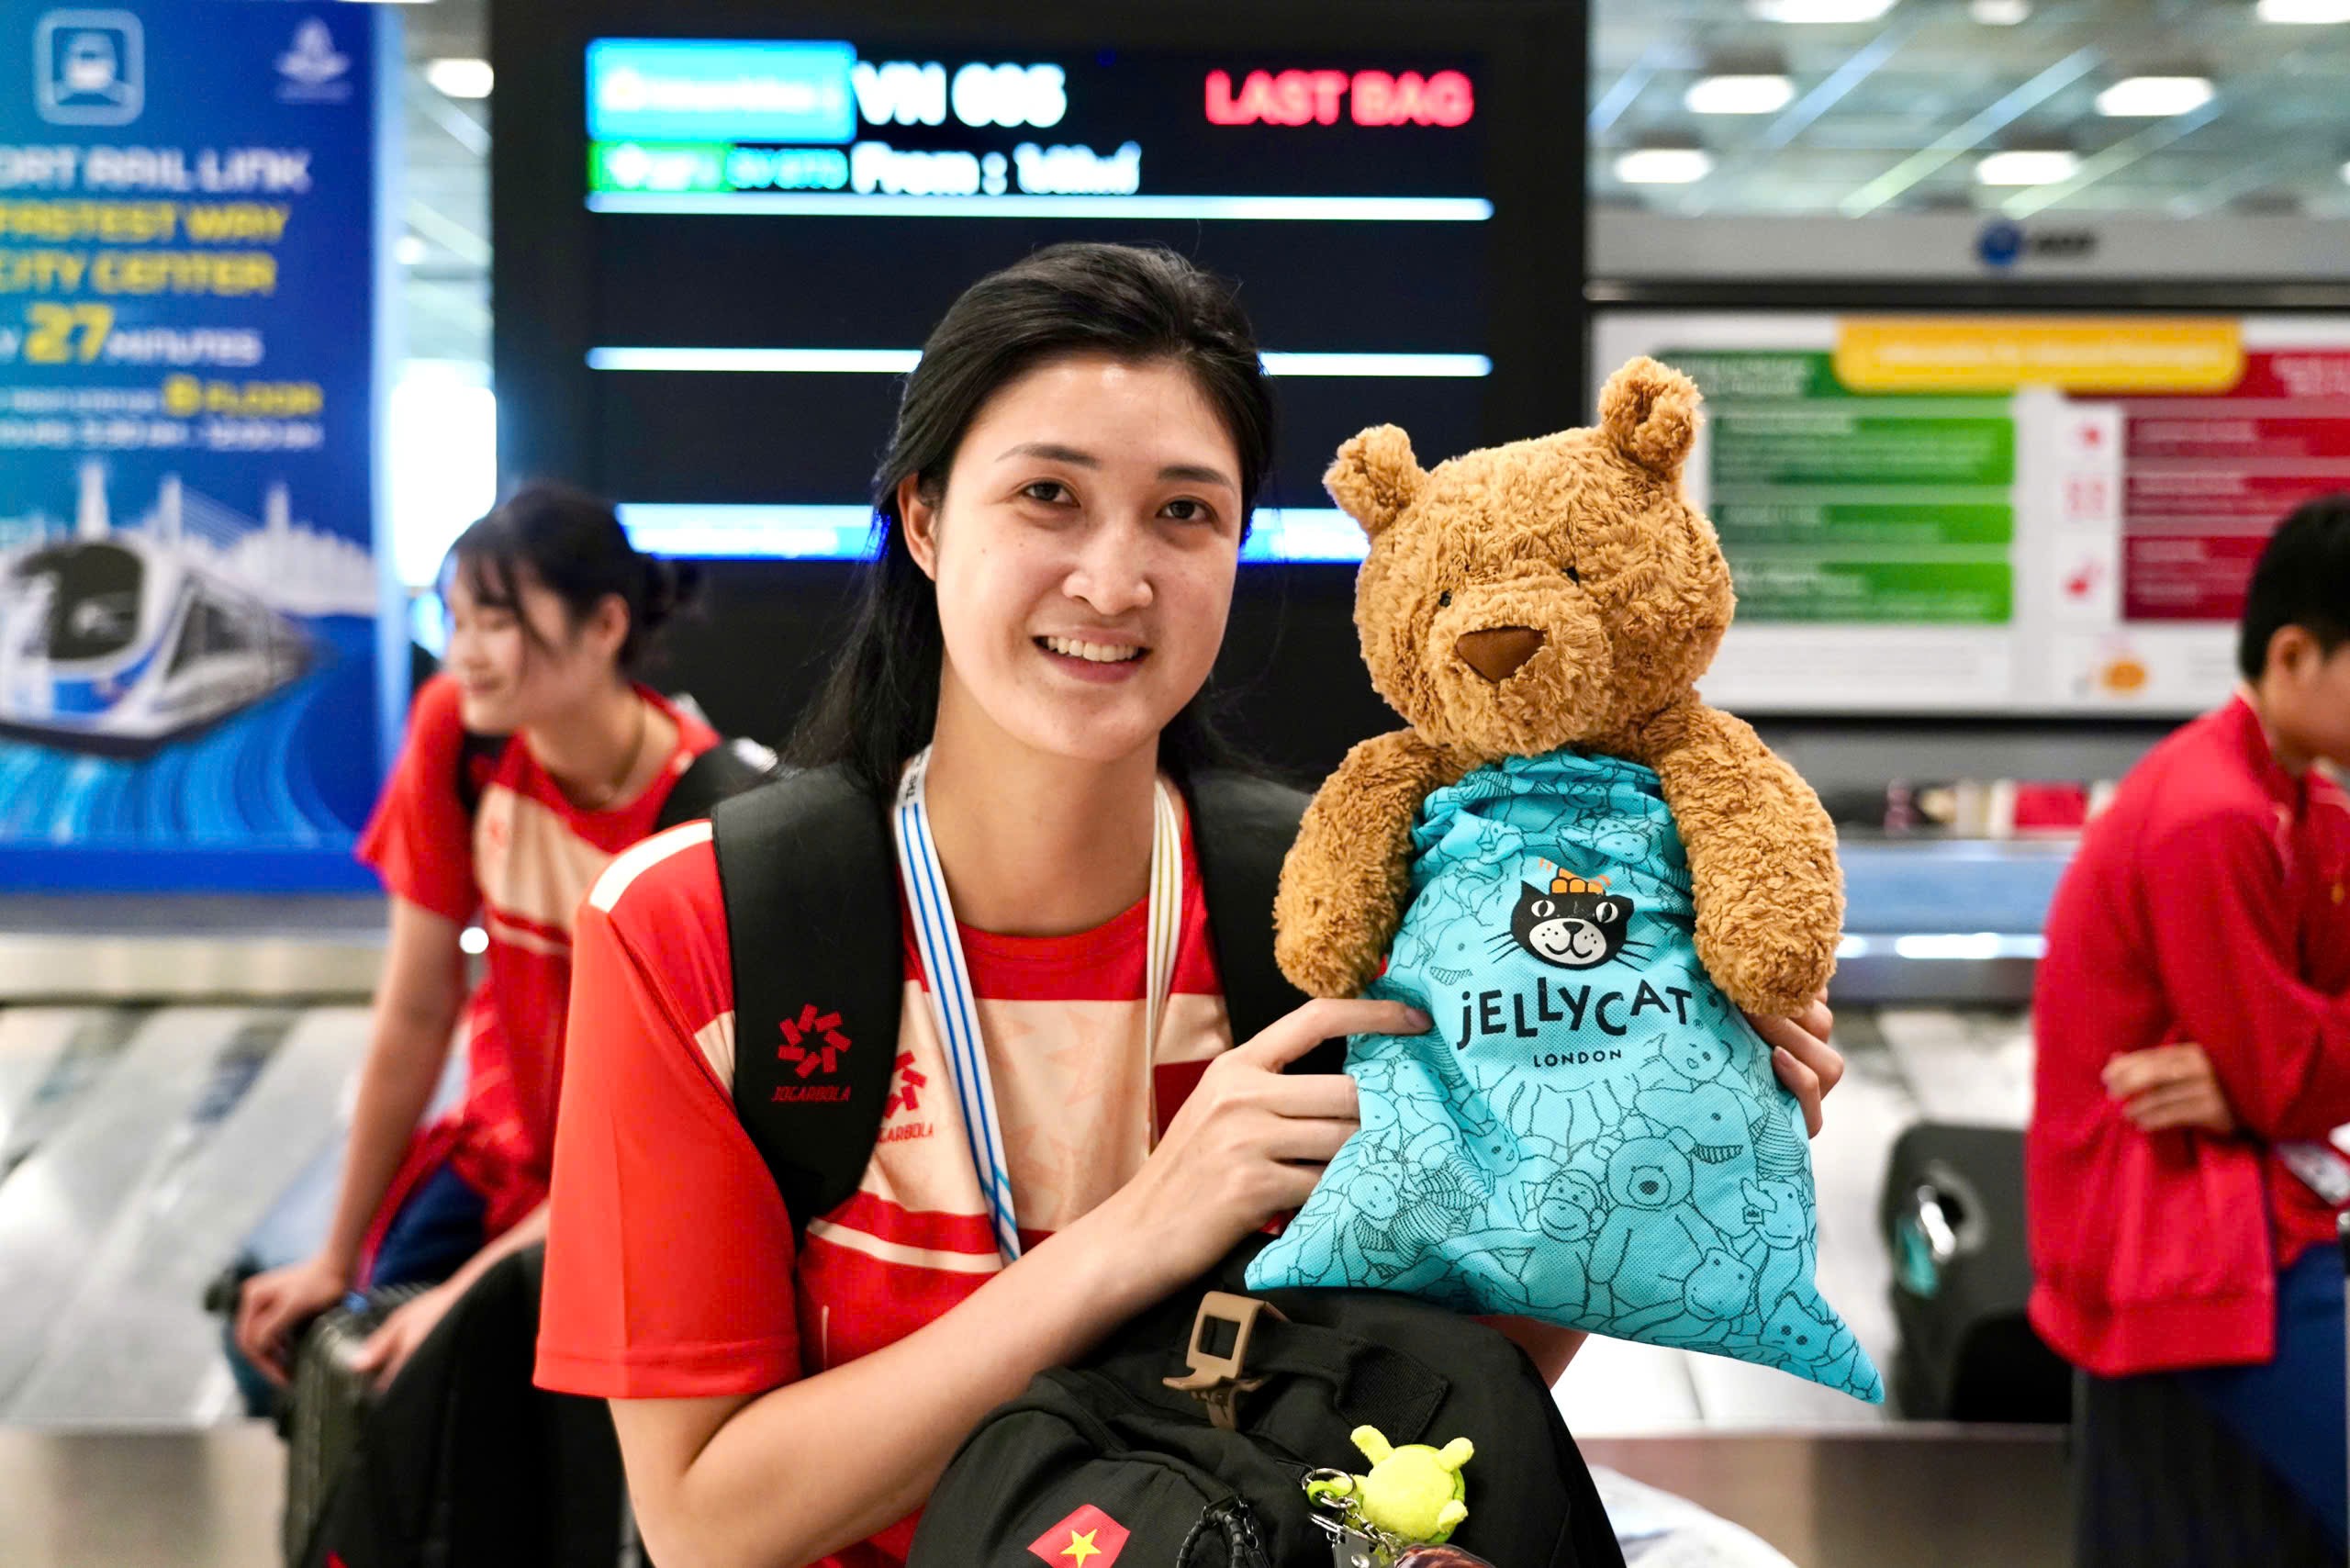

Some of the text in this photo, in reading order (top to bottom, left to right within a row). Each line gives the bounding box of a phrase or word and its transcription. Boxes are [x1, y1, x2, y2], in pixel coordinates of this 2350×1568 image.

[1205, 70, 1474, 127] LAST BAG
[26, 303, 114, 364] 27
[1533, 1049, 1622, 1068] LONDON
